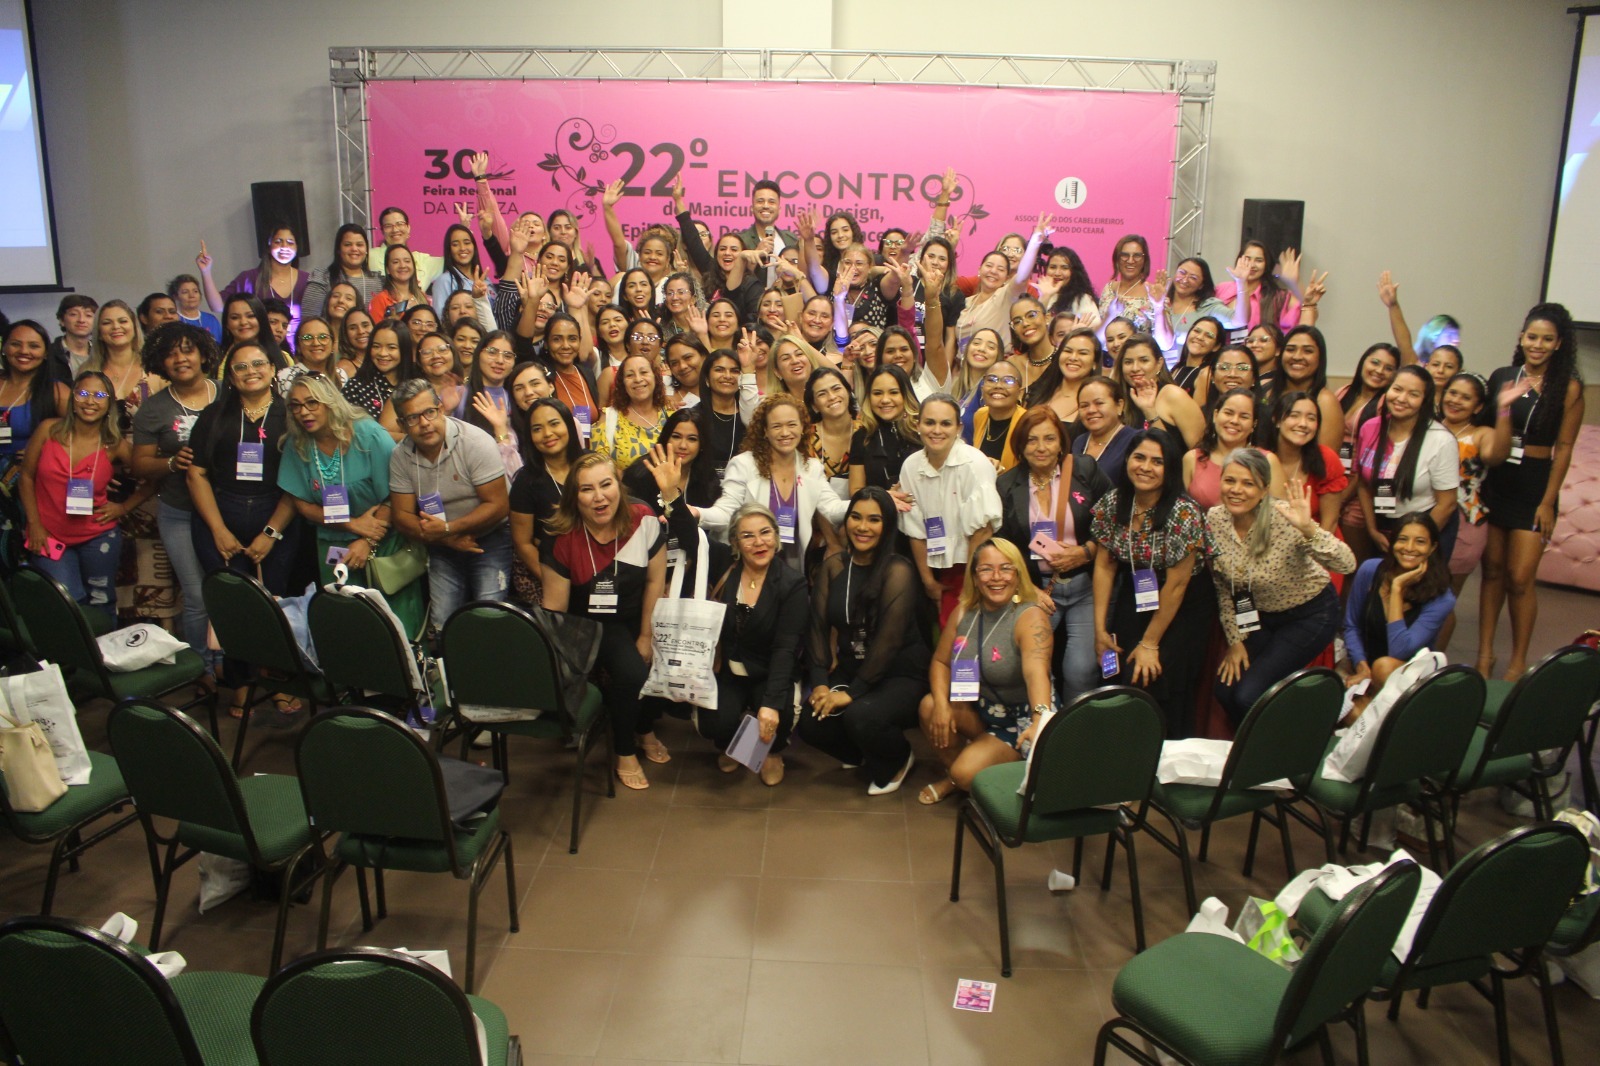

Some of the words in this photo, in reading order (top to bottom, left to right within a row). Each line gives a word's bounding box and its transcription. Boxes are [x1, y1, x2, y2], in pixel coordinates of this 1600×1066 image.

[609, 137, 708, 197] 22º
[718, 169, 946, 202] ENCONTRO
[423, 185, 455, 196] Feira
[459, 186, 517, 198] Renal
[423, 202, 448, 215] DA
[453, 202, 519, 215] BEZA
[688, 201, 754, 217] Manicu
[1014, 215, 1057, 223] ASSOCIO
[1058, 216, 1073, 224] DOS
[1074, 216, 1125, 226] CABELEIREIROS
[1071, 226, 1082, 234] DO
[1083, 225, 1105, 235] CEARÁ
